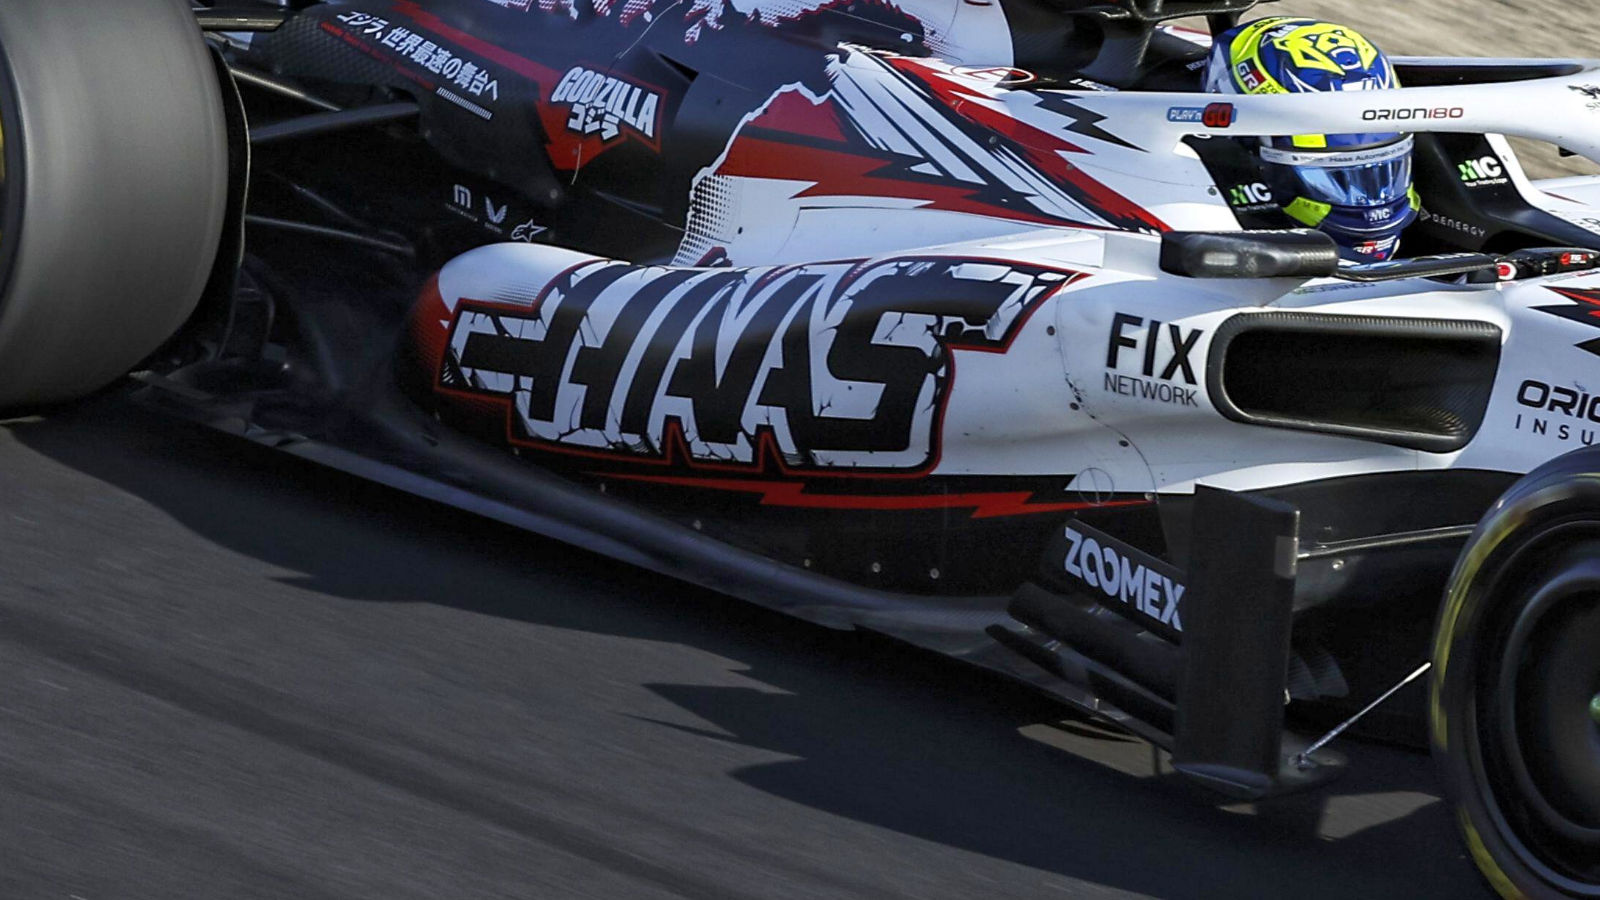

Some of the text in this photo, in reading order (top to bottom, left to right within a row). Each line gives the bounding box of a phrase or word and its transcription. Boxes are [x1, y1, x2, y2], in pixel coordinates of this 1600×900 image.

[551, 66, 659, 138] GODZILLA
[444, 256, 1072, 472] HAAS
[1106, 311, 1204, 386] FIX
[1103, 371, 1199, 408] NETWORK
[1064, 526, 1185, 633] ZOOMEX
